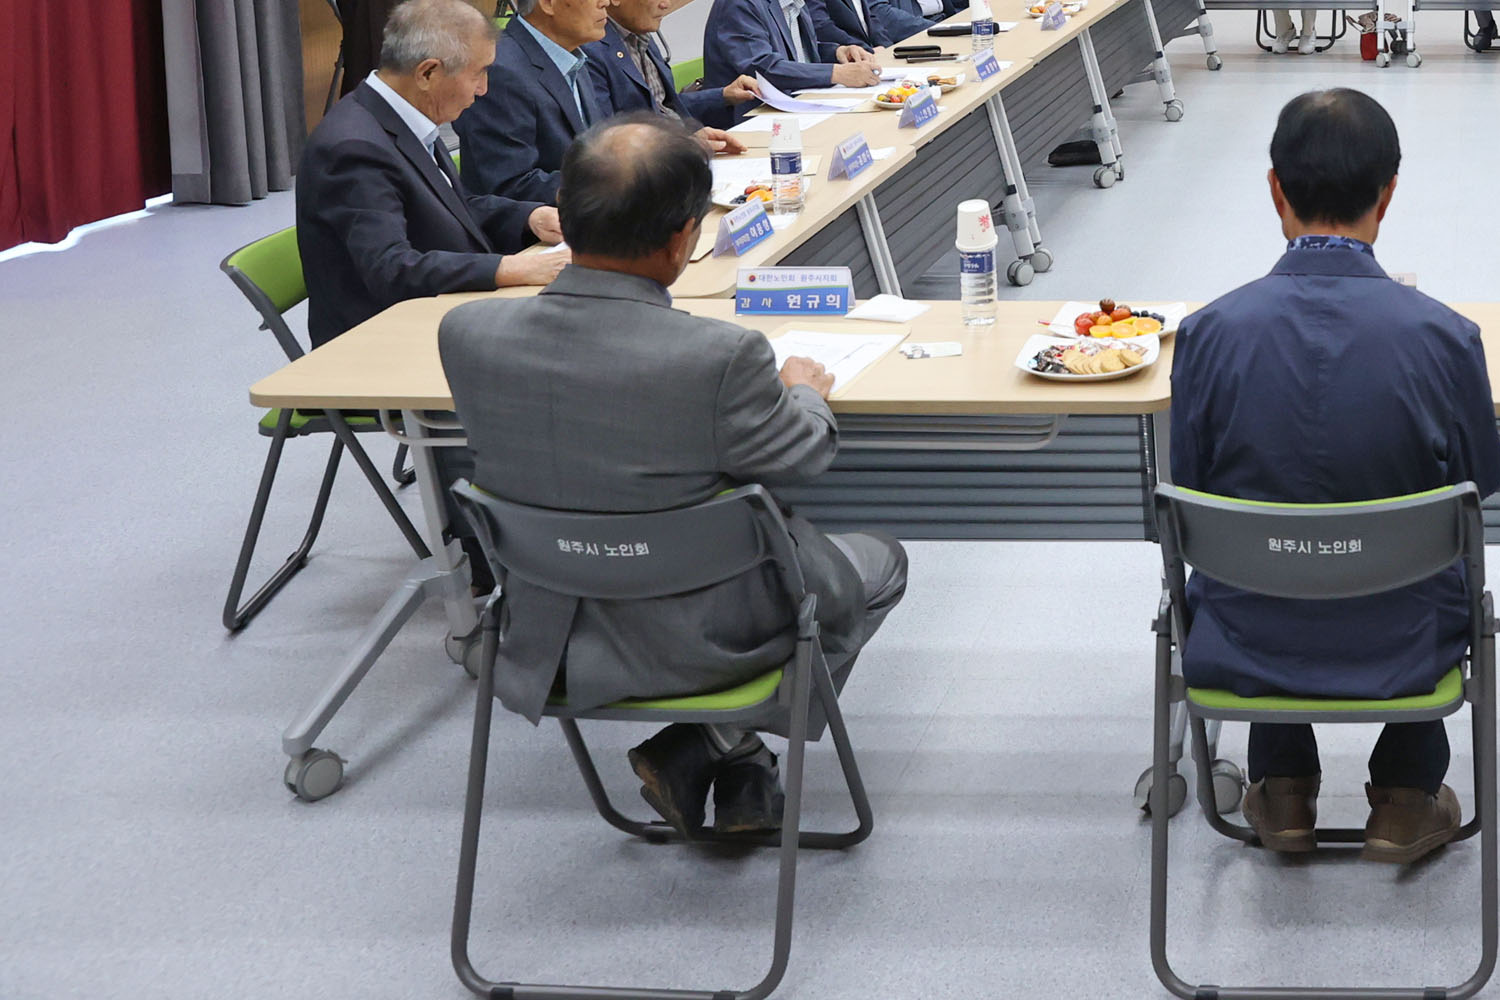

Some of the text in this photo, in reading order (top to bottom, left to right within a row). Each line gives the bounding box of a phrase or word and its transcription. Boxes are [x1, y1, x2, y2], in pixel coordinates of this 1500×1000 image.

[786, 294, 841, 309] 원규희
[557, 538, 650, 557] 원주시 노인회
[1268, 537, 1362, 554] 원주시 노인회
